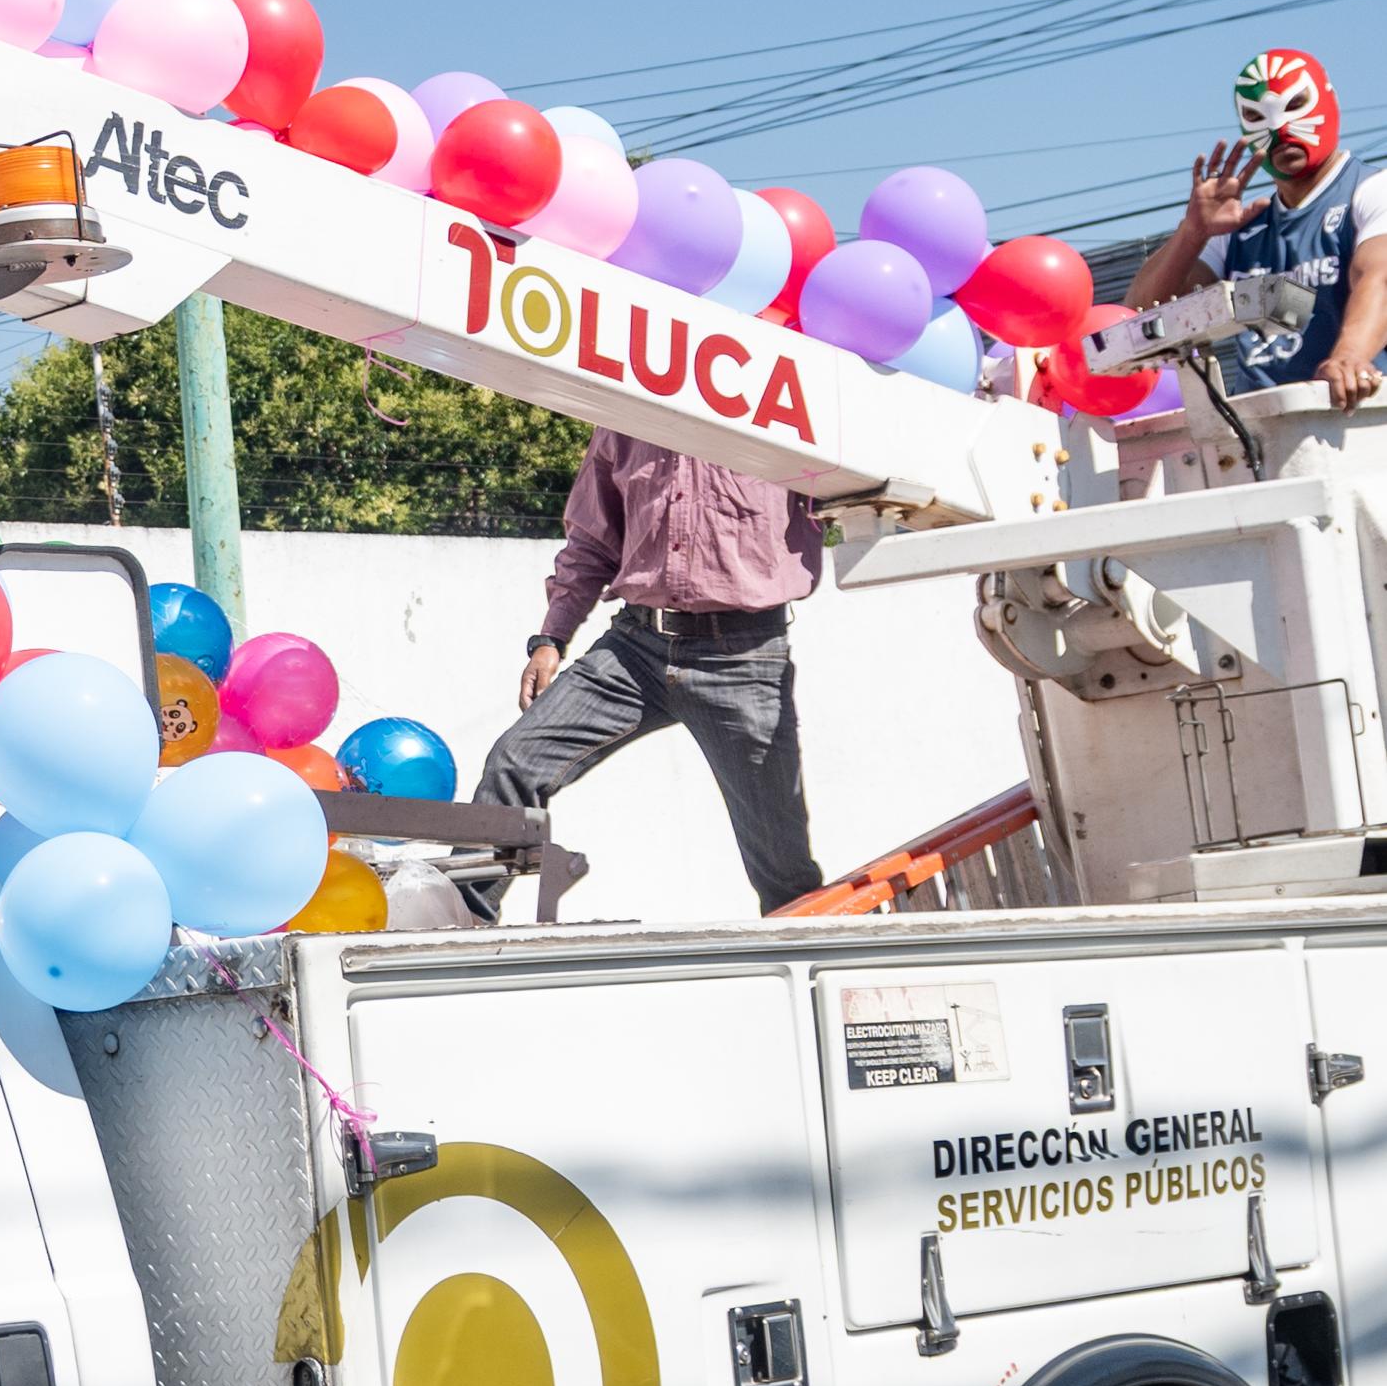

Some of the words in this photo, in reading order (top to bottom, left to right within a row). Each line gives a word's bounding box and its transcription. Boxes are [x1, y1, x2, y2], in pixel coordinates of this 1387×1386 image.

[85, 111, 249, 230] Altec
[447, 221, 817, 445] TOLUCA
[846, 1023, 914, 1039] ELECTROCUTION
[915, 1021, 948, 1036] HAZARD
[866, 1069, 897, 1087] KEEP
[899, 1066, 939, 1085] CLEAR
[1125, 1107, 1263, 1156] GENERAL
[937, 1175, 1114, 1233] SERVICIOS
[1126, 1153, 1266, 1209] PÚBLICOS
